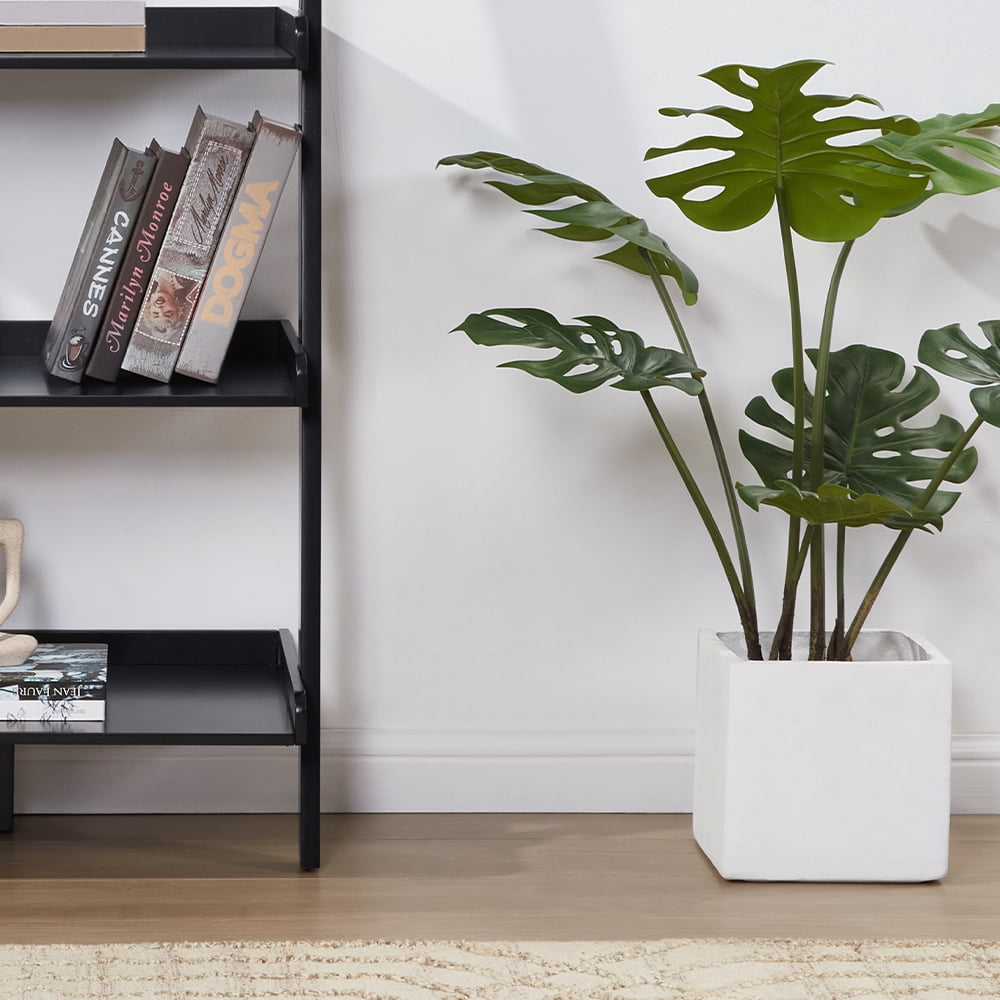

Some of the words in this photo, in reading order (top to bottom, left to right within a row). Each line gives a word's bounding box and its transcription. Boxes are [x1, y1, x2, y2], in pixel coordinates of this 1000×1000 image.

[82, 211, 130, 318] CANNES
[105, 267, 144, 353] Marilyn
[136, 181, 173, 263] Monroe
[200, 180, 279, 329] DOGMA
[53, 684, 83, 697] JEAN
